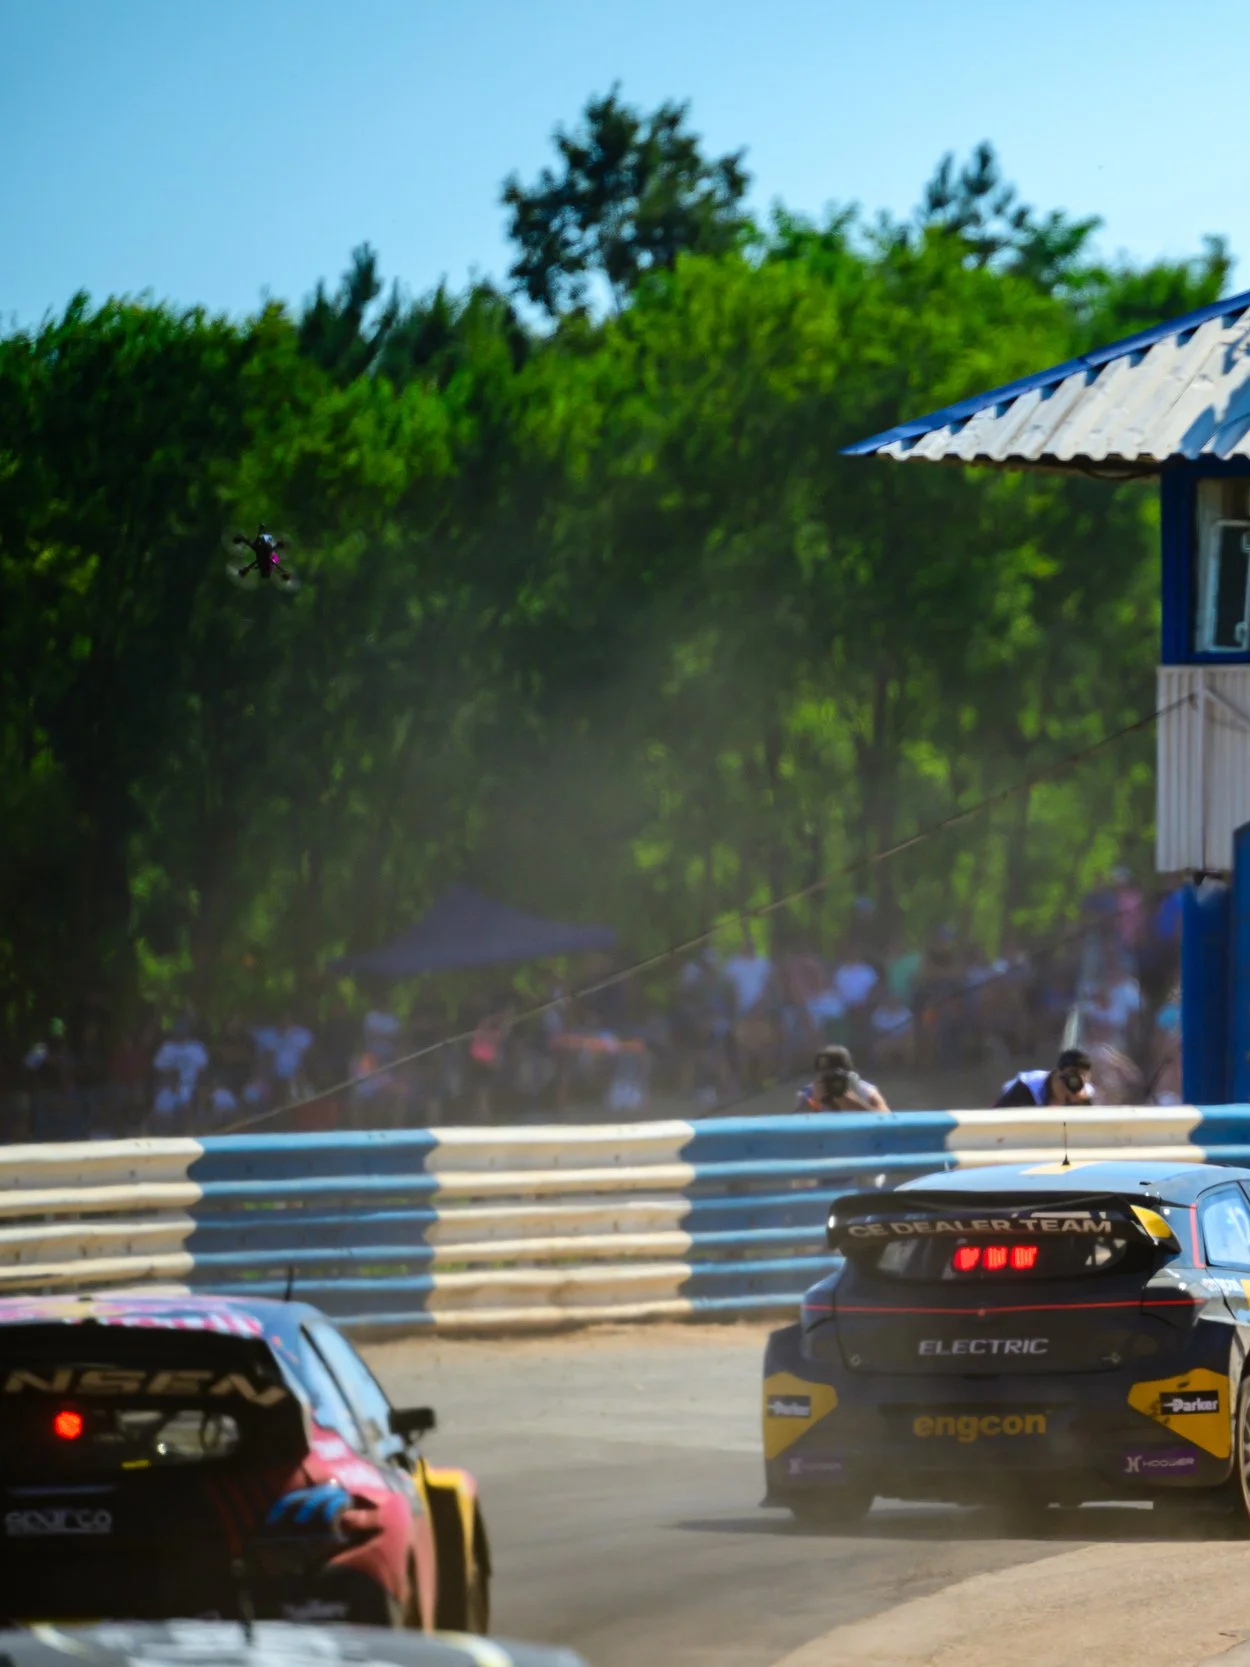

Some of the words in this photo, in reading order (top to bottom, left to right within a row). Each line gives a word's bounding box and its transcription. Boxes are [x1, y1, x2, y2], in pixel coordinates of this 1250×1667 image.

[849, 1223, 888, 1238] CE
[890, 1219, 1012, 1236] DEALER
[1019, 1218, 1112, 1234] TEAM
[919, 1338, 1050, 1356] ELECTRIC
[1171, 1397, 1218, 1413] Parker
[912, 1413, 1046, 1444] engcon
